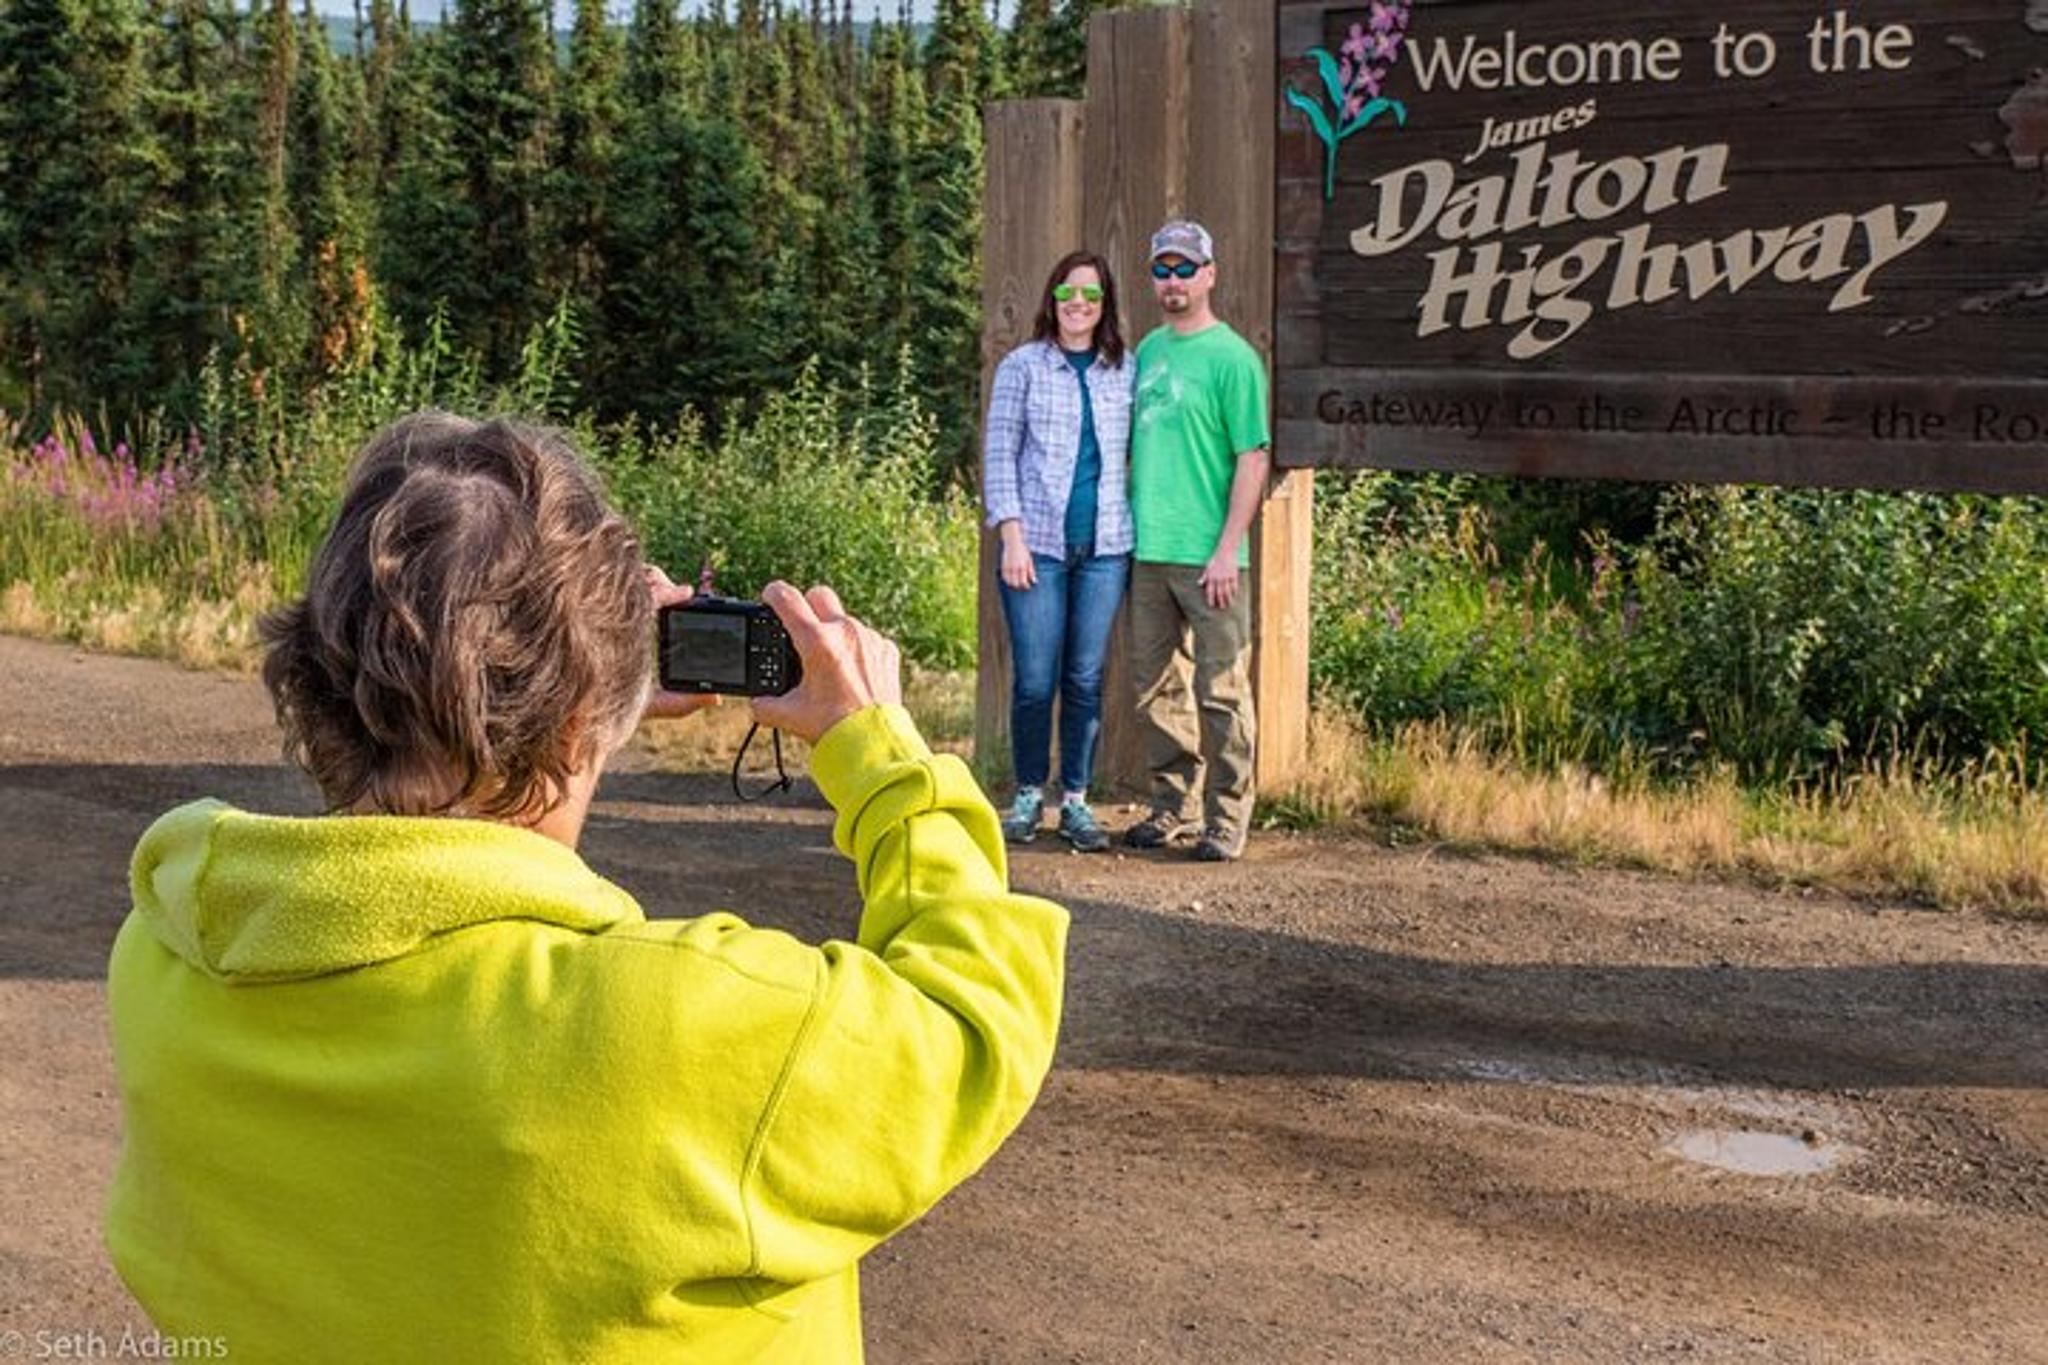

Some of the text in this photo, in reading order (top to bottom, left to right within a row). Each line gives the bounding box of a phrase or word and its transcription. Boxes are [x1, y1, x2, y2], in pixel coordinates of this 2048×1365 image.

[1405, 11, 1914, 92] Welcome to the
[1464, 99, 1598, 164] James
[1350, 142, 1730, 257] Dalton
[1417, 201, 1949, 360] Highway
[1316, 389, 1494, 440] Gateway
[1514, 395, 1555, 430] to
[1577, 392, 1643, 433] the
[1666, 396, 1801, 437] Arctic
[1871, 402, 1945, 441] the
[1974, 403, 2048, 444] Ro
